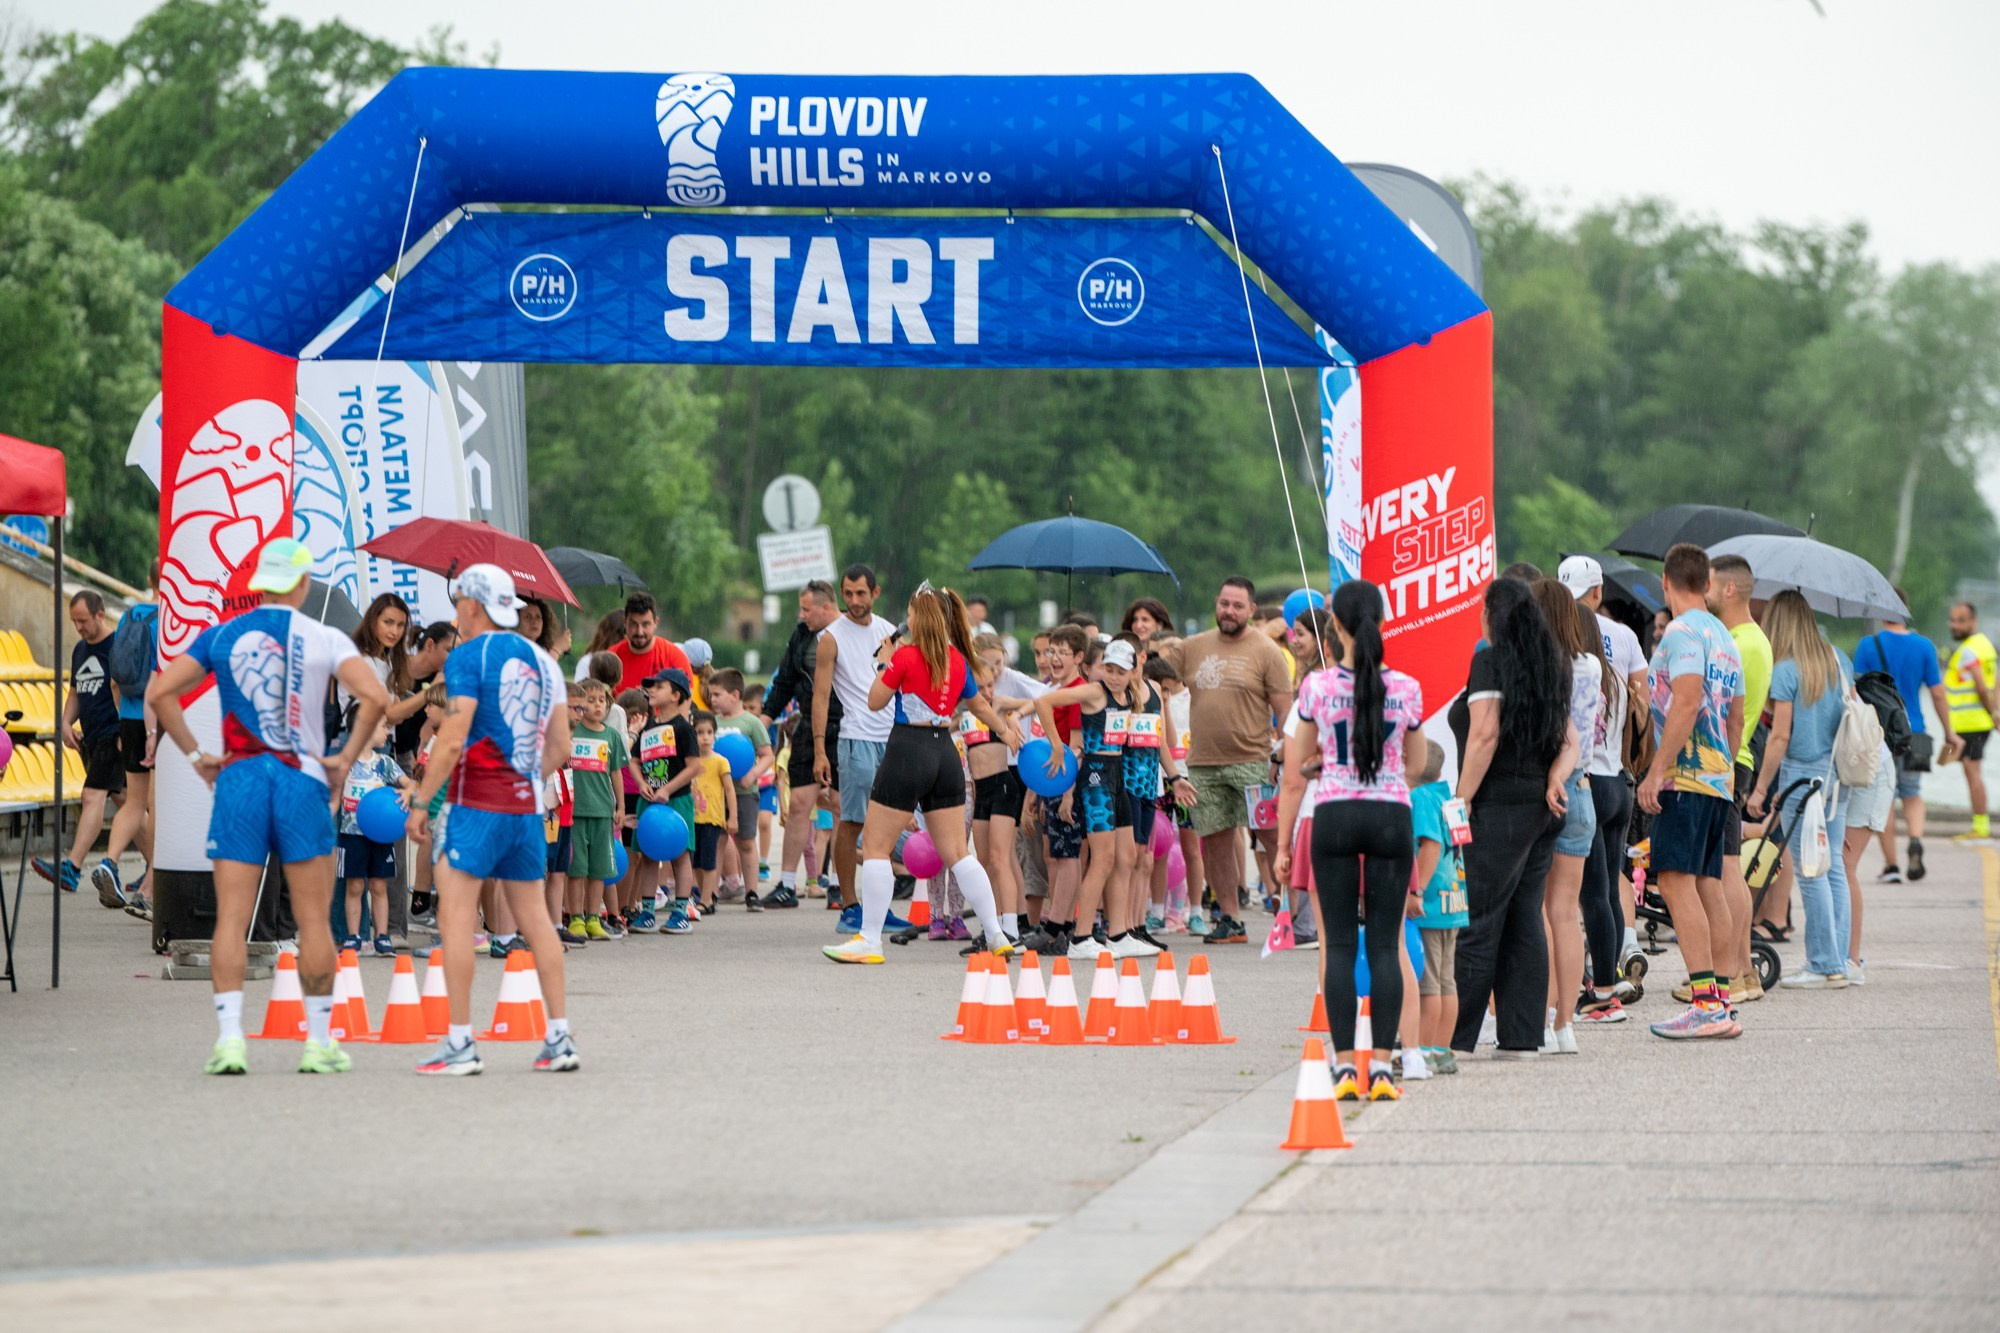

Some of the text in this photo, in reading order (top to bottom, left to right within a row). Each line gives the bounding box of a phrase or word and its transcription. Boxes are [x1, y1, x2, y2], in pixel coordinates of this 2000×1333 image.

[750, 96, 928, 136] PLOVDIV
[750, 147, 865, 187] HILLS
[877, 153, 899, 166] IN
[877, 171, 992, 184] MARKOVO
[522, 274, 565, 297] P/H
[663, 233, 995, 345] START
[1089, 278, 1133, 302] P/H
[1392, 496, 1486, 575] STEP
[1378, 532, 1493, 623] ATTERS
[290, 633, 305, 694] MATTERS
[76, 679, 104, 696] REEF
[288, 694, 300, 728] STEP
[1136, 720, 1151, 731] 64
[575, 744, 592, 756] 85
[645, 734, 659, 748] 105
